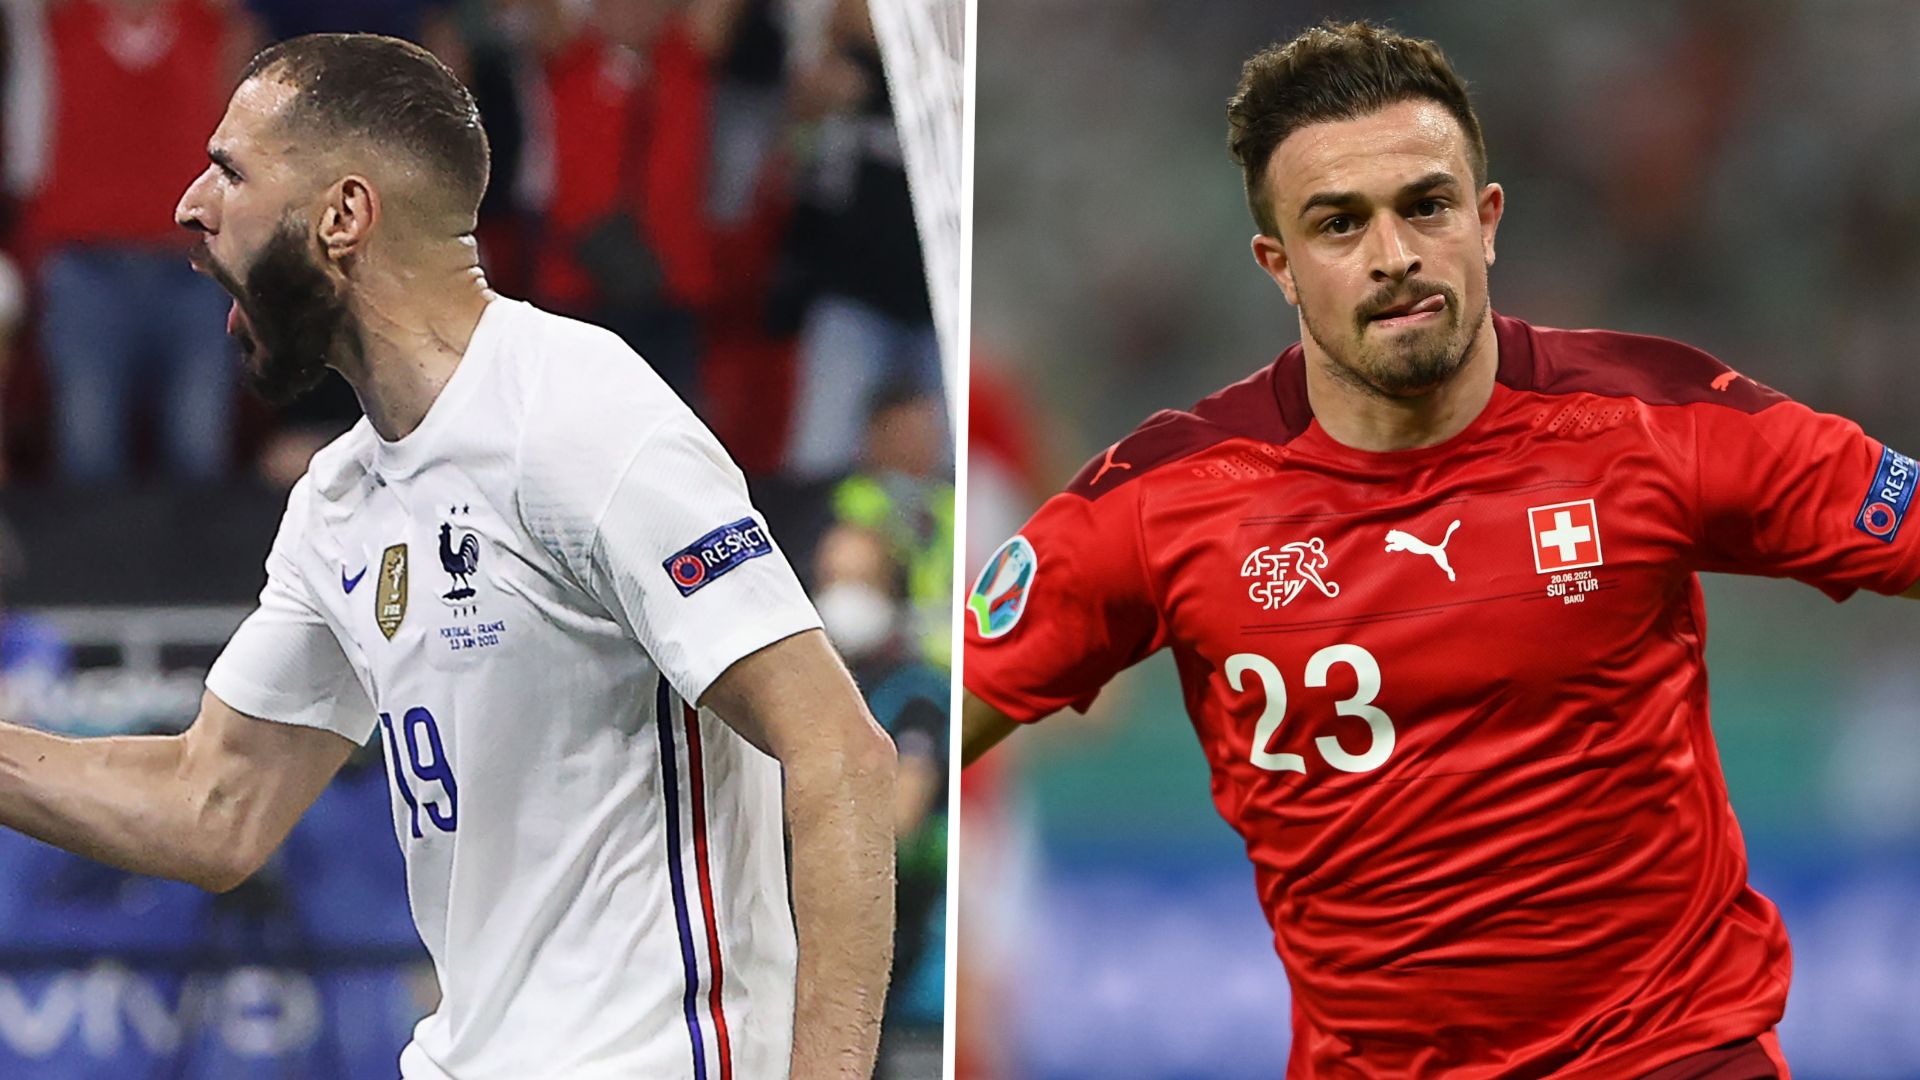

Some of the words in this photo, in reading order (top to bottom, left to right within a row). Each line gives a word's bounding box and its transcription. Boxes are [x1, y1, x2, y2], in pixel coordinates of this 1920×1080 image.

[1551, 570, 1592, 584] 20.06.2021
[1546, 583, 1567, 597] SUI
[1576, 578, 1599, 593] TUR
[1564, 594, 1585, 605] BAKU
[477, 620, 506, 634] FRANCE
[477, 634, 499, 647] 2021
[1224, 644, 1396, 775] 23
[379, 706, 458, 839] 19
